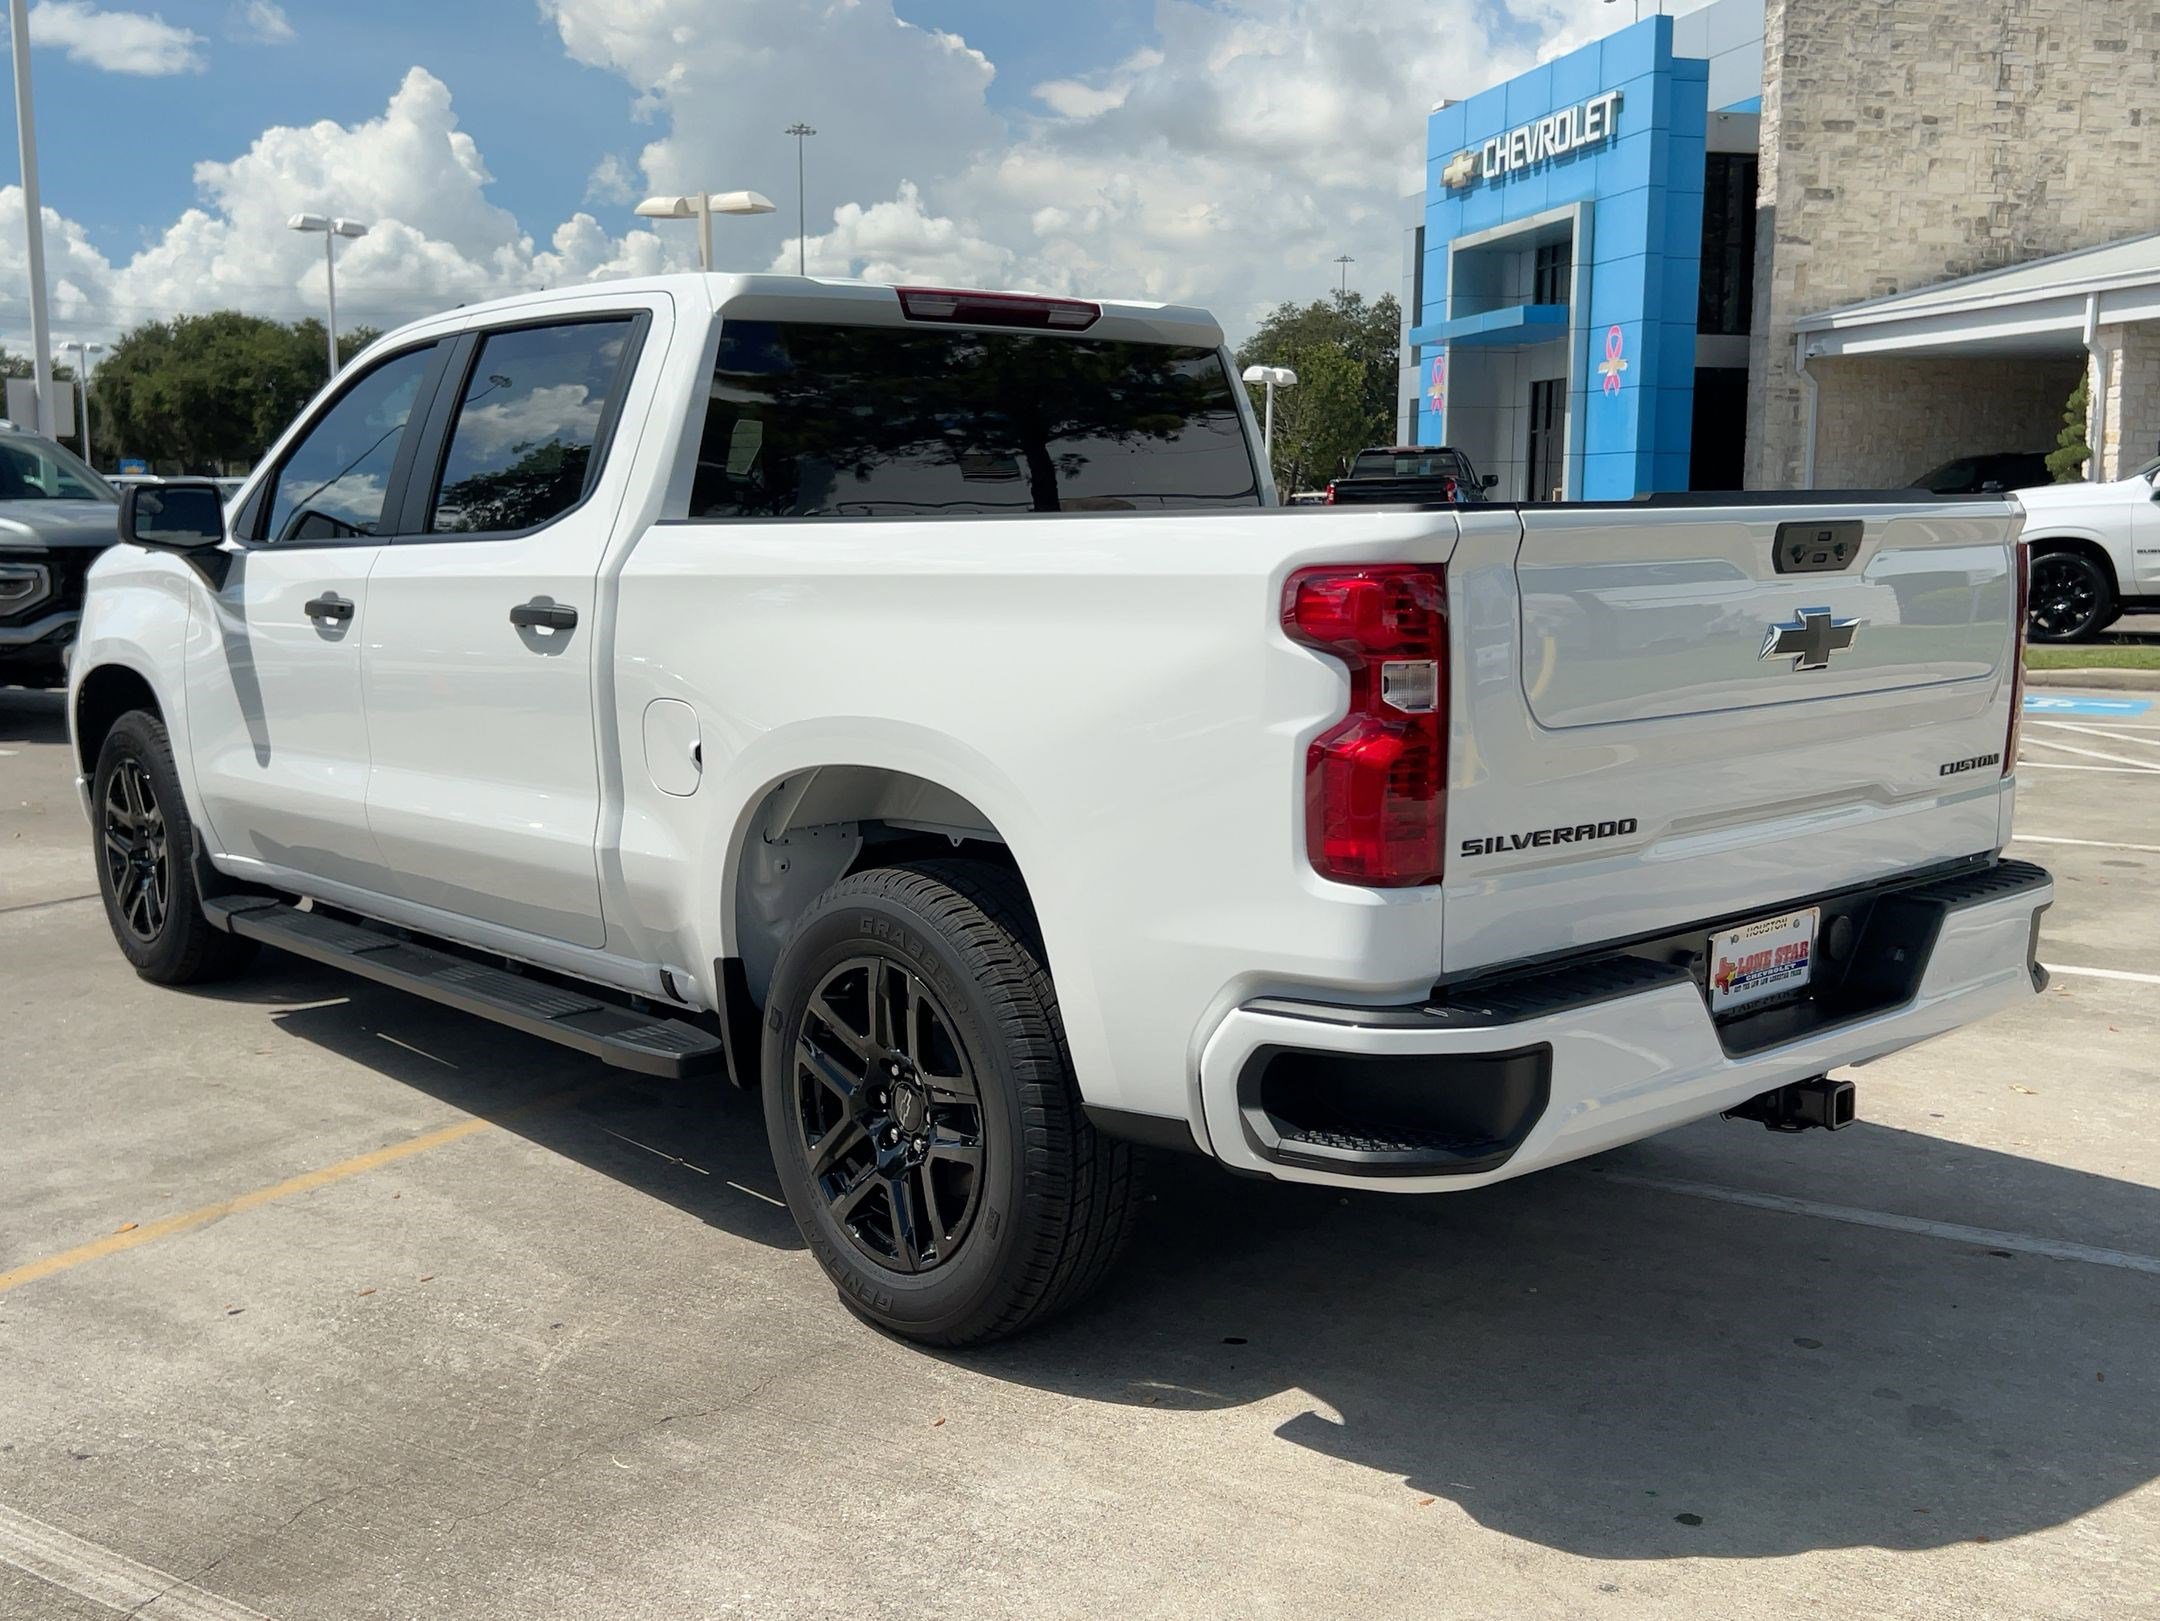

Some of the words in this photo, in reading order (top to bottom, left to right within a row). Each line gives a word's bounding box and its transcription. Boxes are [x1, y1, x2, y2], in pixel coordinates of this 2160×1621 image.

[1482, 90, 1623, 179] CHEVROLET
[1939, 753, 1999, 776] CUSTOM
[1460, 817, 1638, 858] SILVERADO
[1745, 918, 1788, 938] HOUSTON
[859, 914, 968, 1014] GRABBER
[1736, 950, 1773, 976] LONE
[1774, 941, 1809, 965] STAR
[1745, 963, 1797, 982] CHEVROLET
